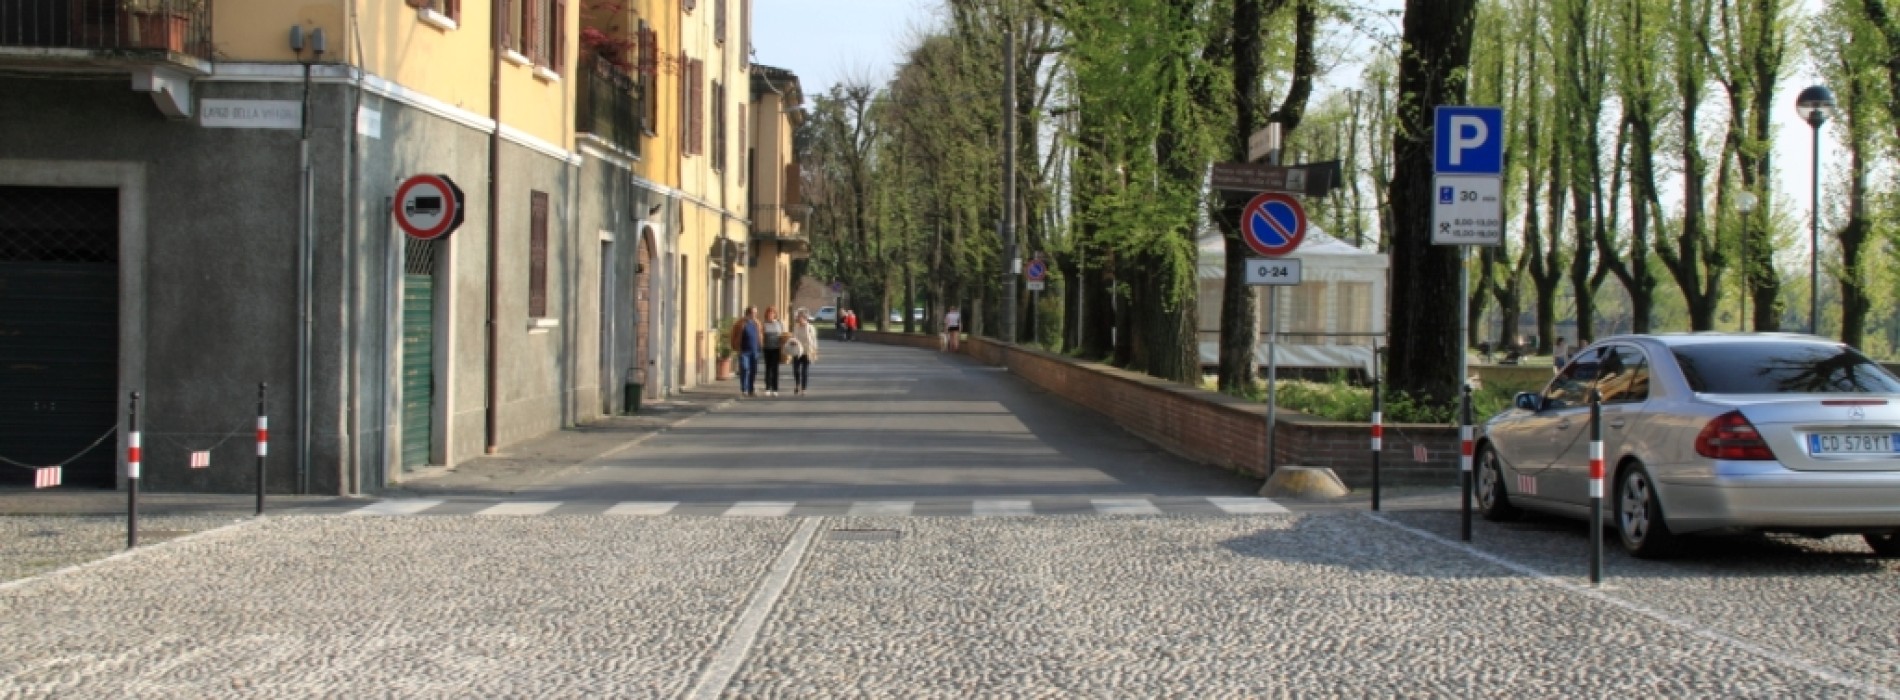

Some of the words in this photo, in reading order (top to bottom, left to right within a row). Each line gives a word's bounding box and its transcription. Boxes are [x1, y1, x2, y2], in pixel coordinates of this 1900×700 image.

[1450, 115, 1488, 165] P
[1460, 190, 1478, 202] 30
[1257, 266, 1289, 278] 0-24
[1822, 435, 1839, 451] CD
[1844, 435, 1890, 451] 578YT
